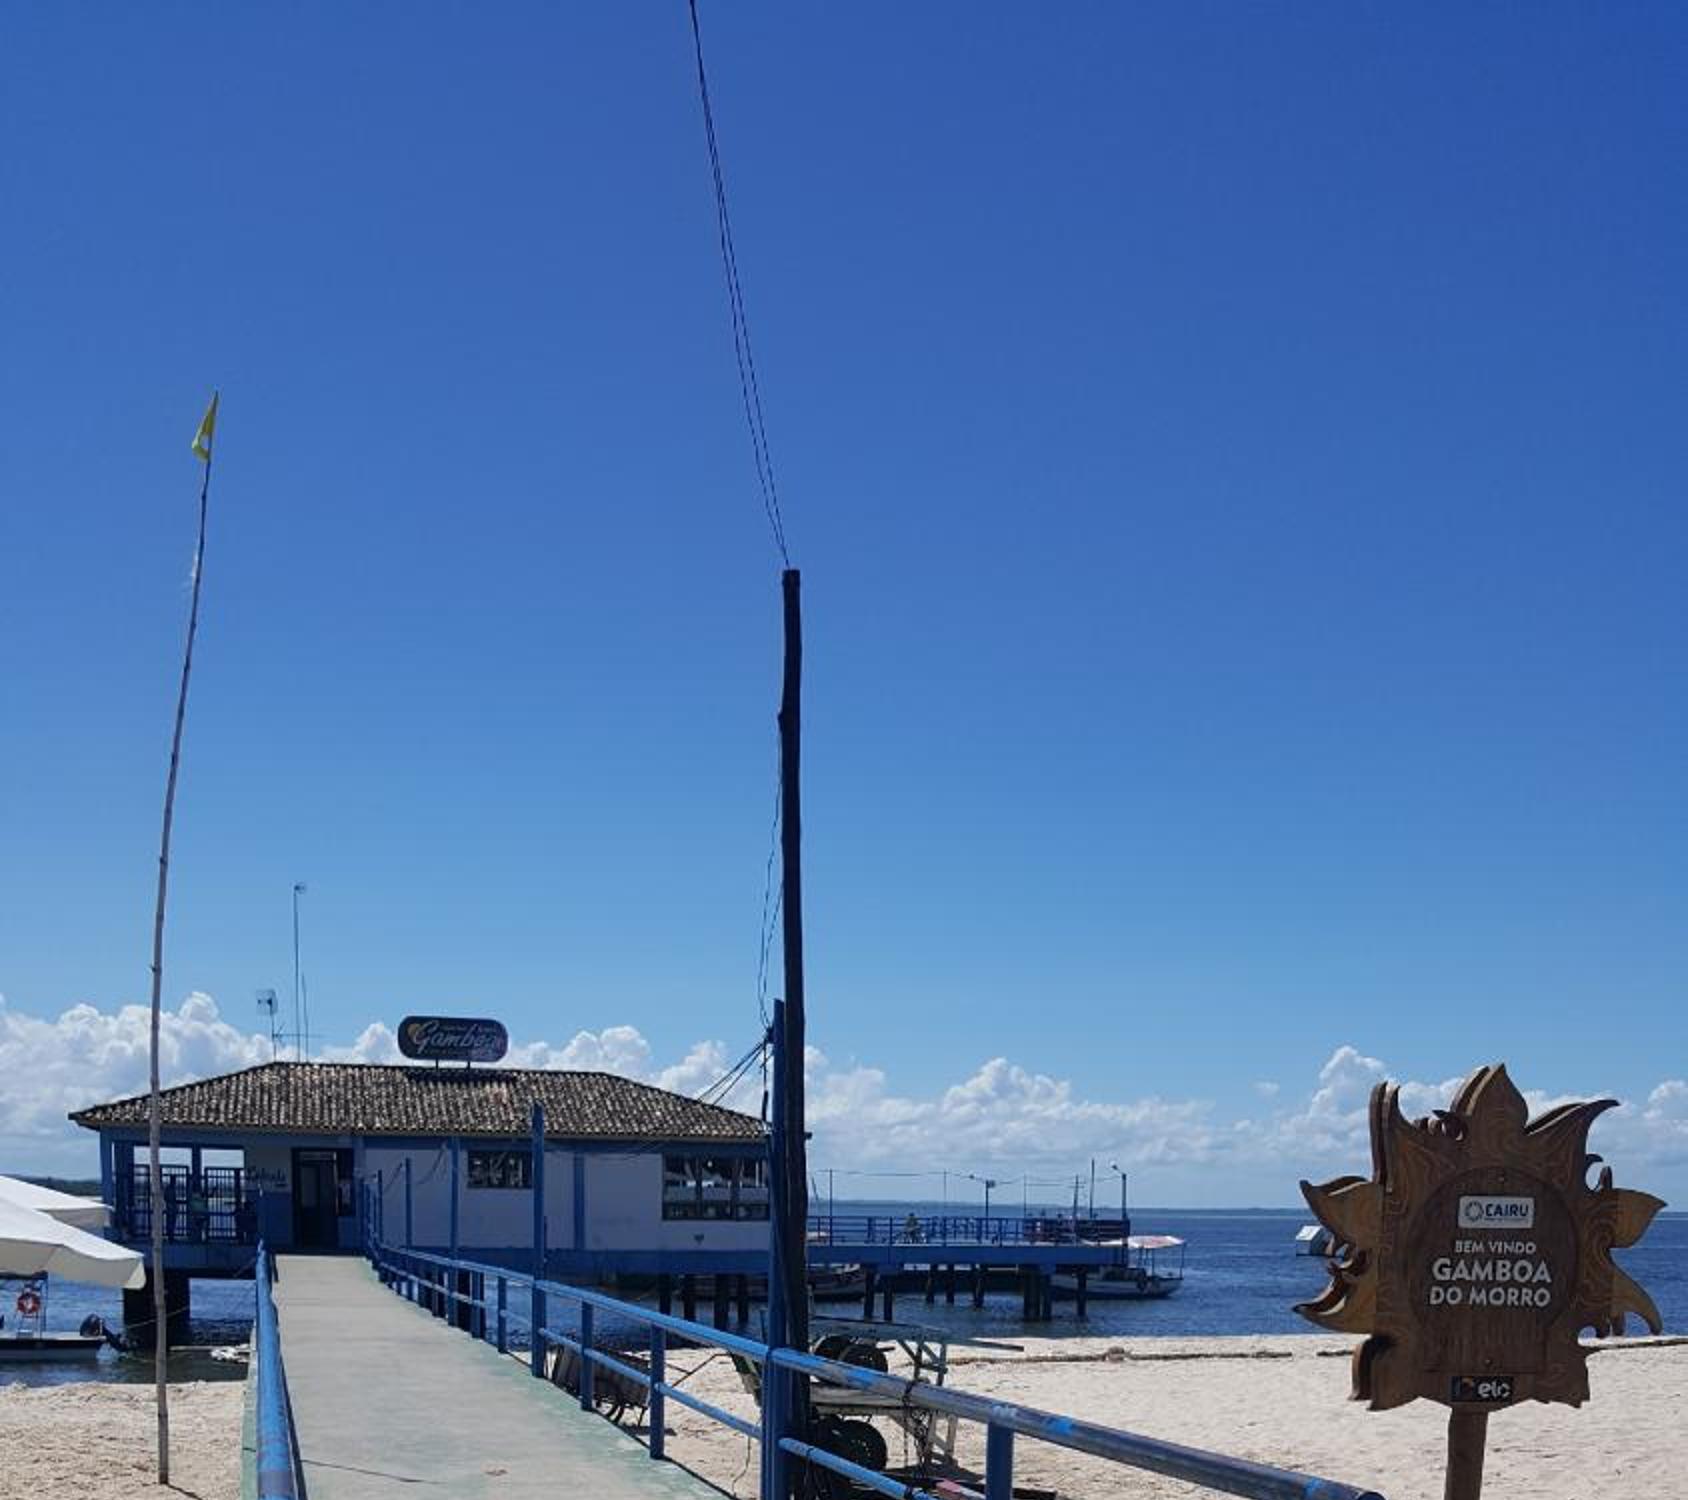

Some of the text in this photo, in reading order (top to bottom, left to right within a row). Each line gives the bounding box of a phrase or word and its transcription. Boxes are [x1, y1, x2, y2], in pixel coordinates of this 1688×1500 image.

[1485, 1203, 1529, 1217] CAIRU
[1455, 1239, 1537, 1255] BEM VINDO
[1432, 1257, 1552, 1283] GAMBOA
[1429, 1286, 1551, 1307] DO MORRO
